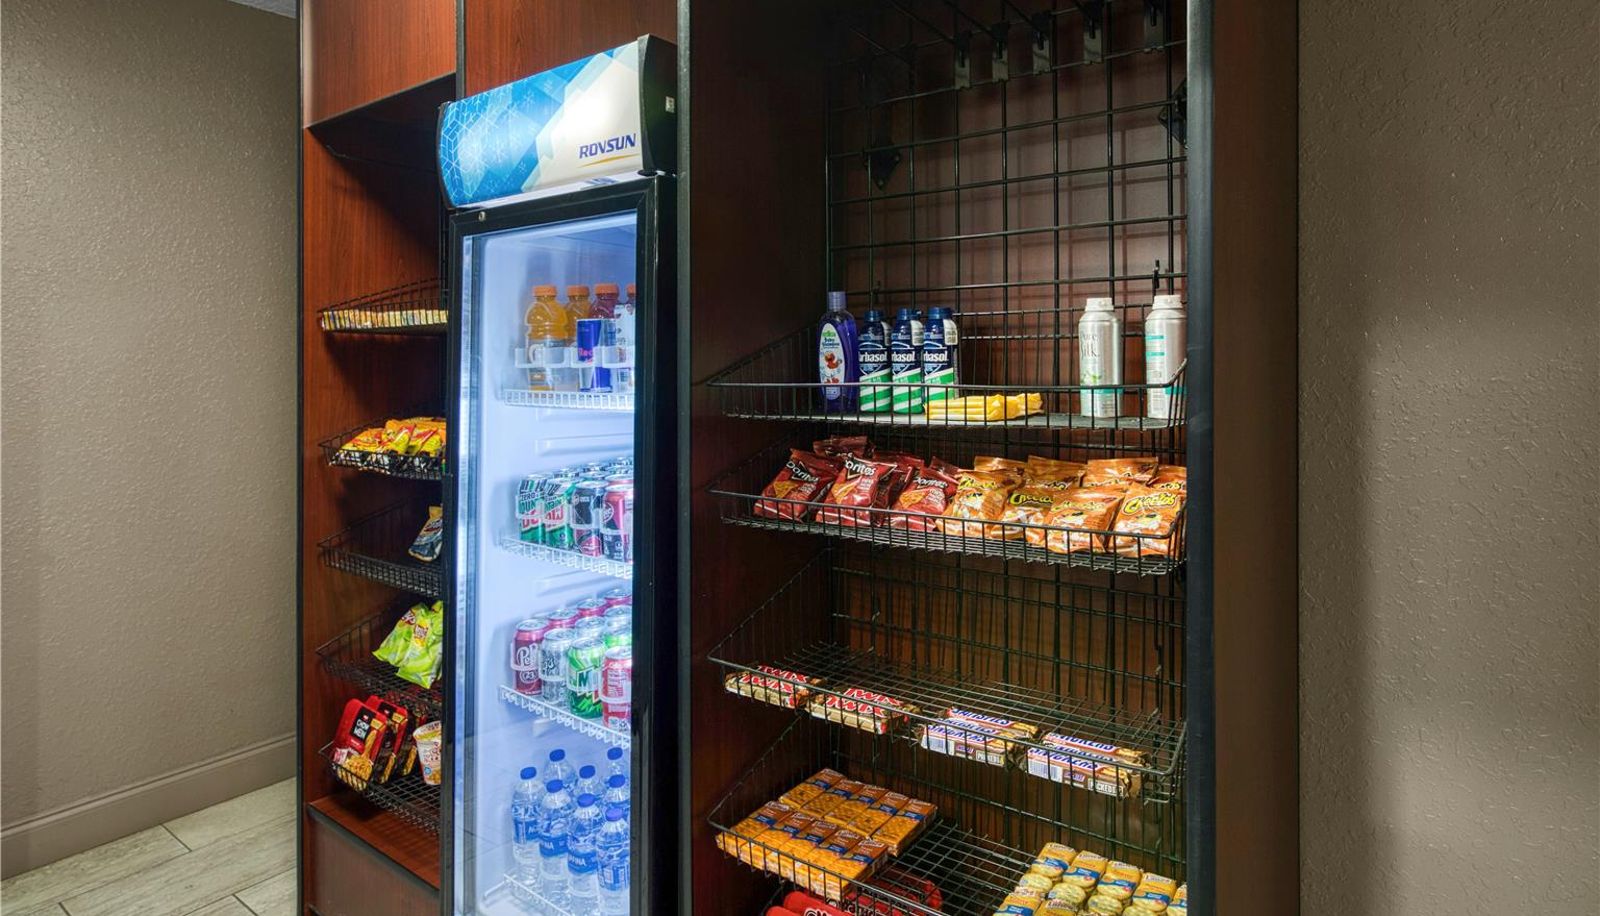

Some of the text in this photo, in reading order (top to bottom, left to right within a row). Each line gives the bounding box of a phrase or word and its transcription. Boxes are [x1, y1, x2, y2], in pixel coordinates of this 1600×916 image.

[578, 133, 637, 159] ROVSUN
[845, 459, 877, 476] oritos
[1123, 491, 1177, 514] Cheetos
